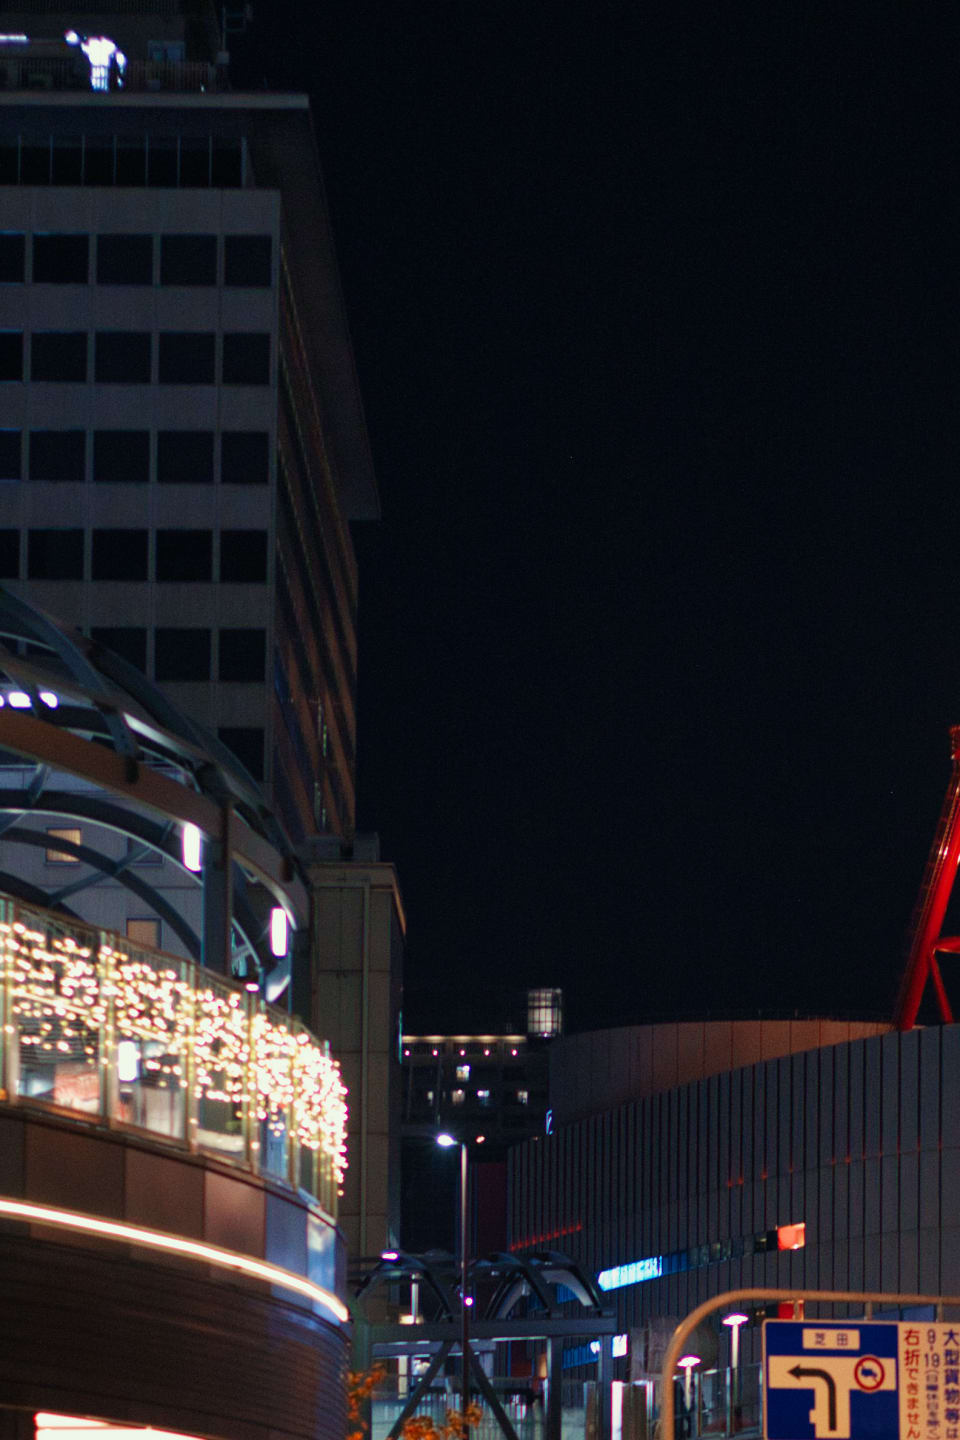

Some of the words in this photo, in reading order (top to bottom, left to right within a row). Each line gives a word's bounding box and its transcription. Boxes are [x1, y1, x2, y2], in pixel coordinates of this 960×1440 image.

[904, 1328, 920, 1440] 右折できません
[943, 1328, 960, 1439] 大型貨物等は
